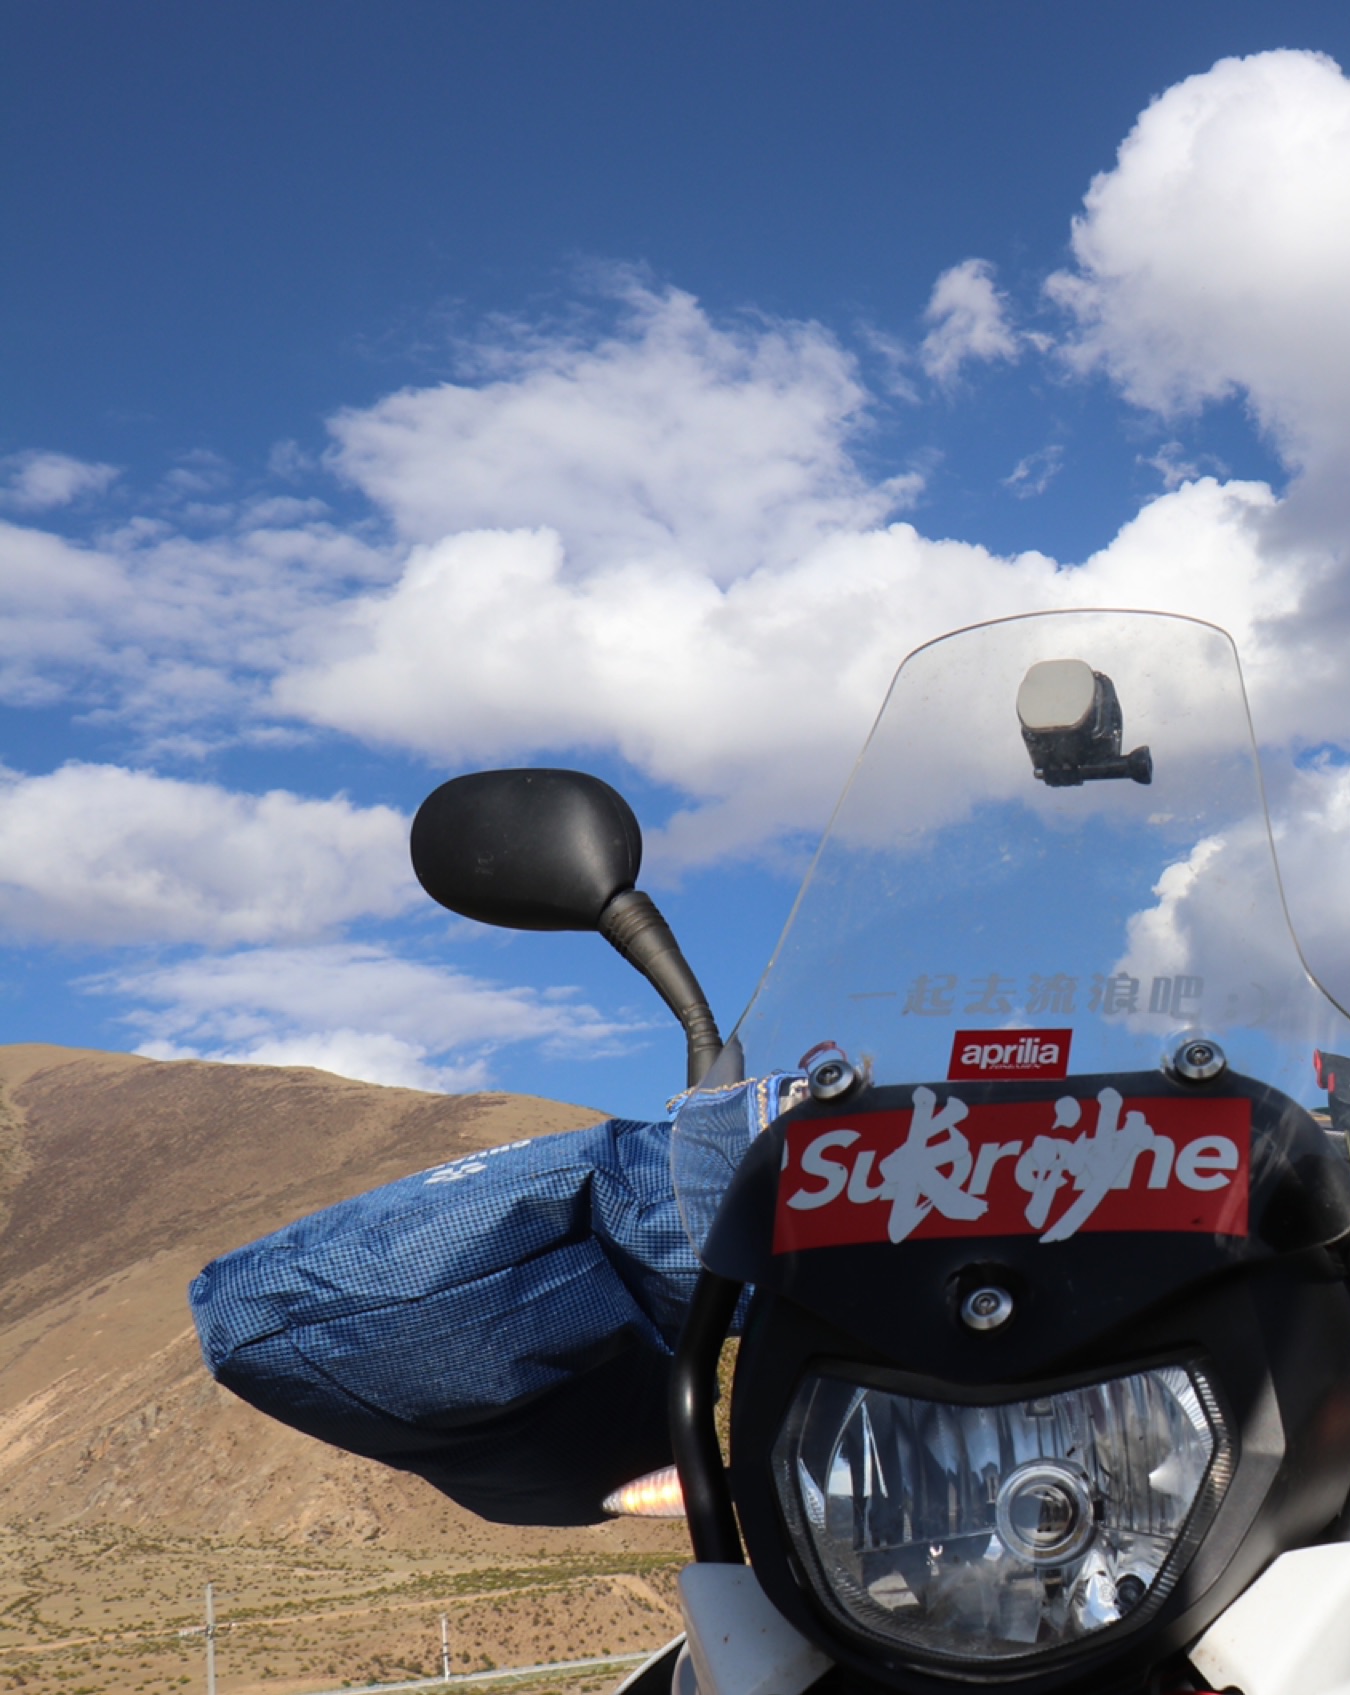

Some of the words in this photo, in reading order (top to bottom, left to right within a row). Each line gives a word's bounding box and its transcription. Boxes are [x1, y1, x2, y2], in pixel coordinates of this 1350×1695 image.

[848, 972, 1204, 1019] 一起去流浪吧
[961, 1037, 1060, 1069] aprilia
